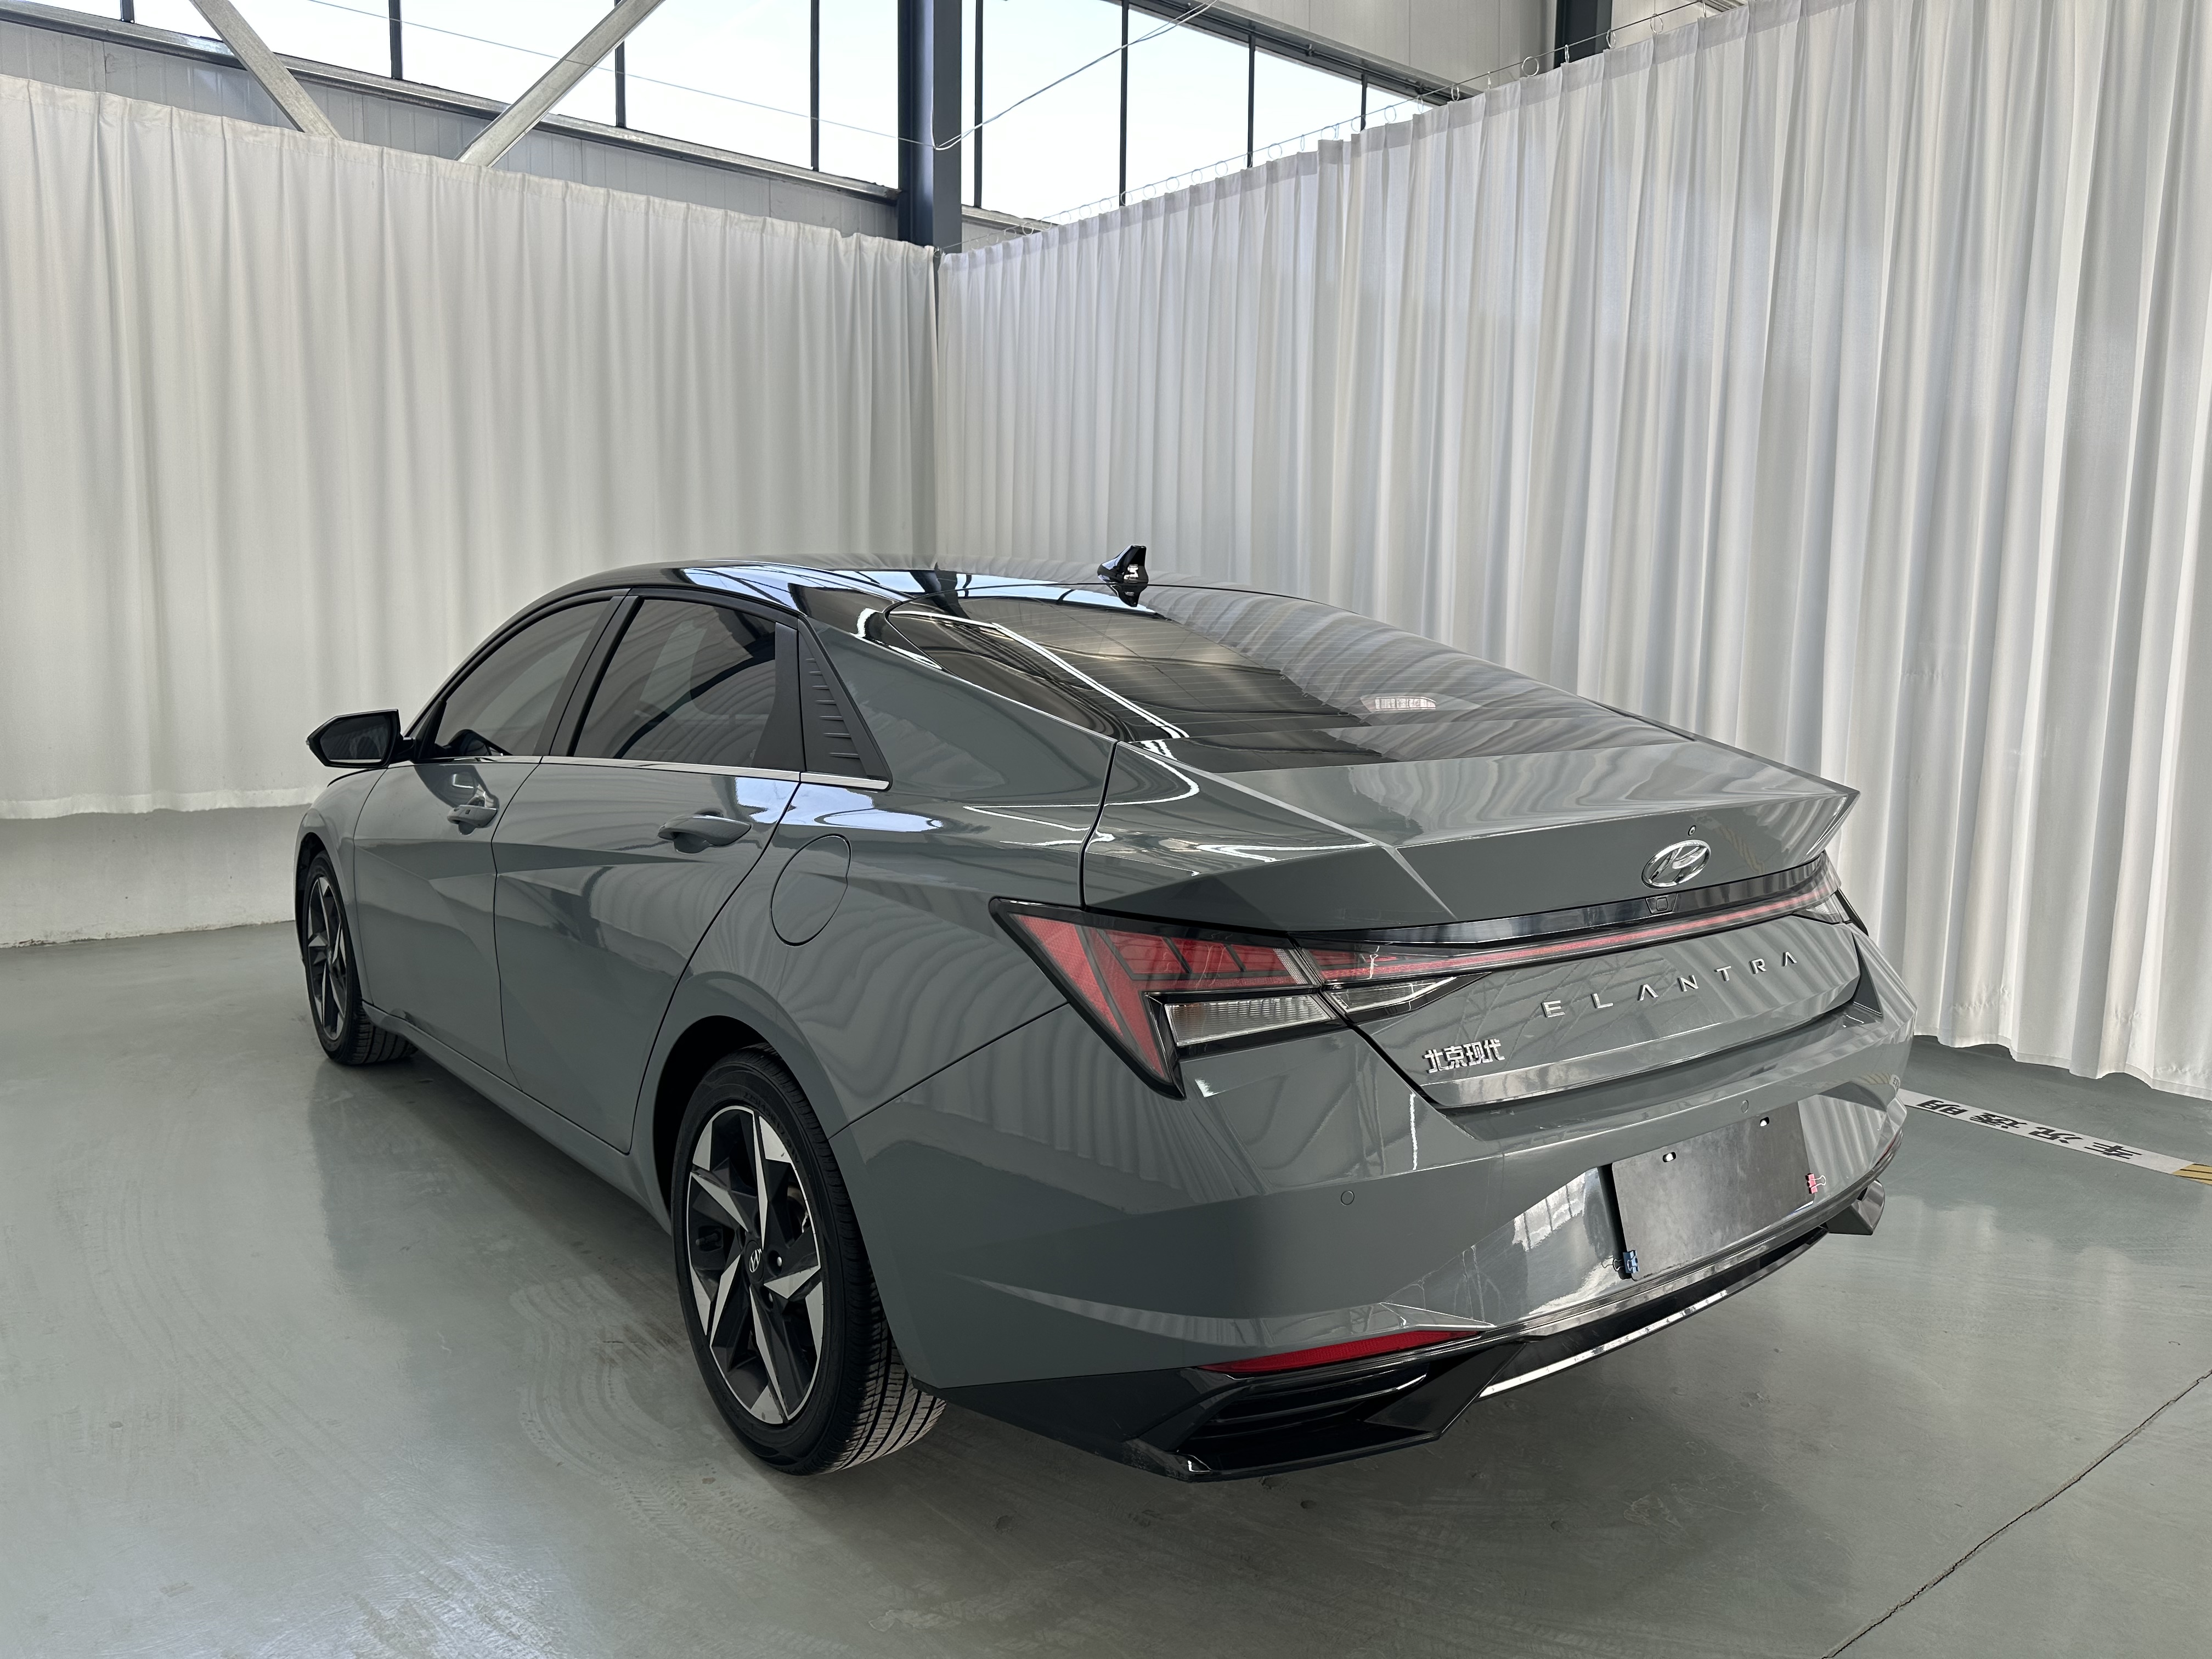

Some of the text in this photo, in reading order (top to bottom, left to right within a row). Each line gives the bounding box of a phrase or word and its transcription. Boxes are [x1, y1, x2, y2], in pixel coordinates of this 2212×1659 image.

[1542, 951, 1797, 1018] ELANTRA
[1423, 1039, 1505, 1074] 北京现代
[1916, 1099, 2142, 1159] 车况透明
